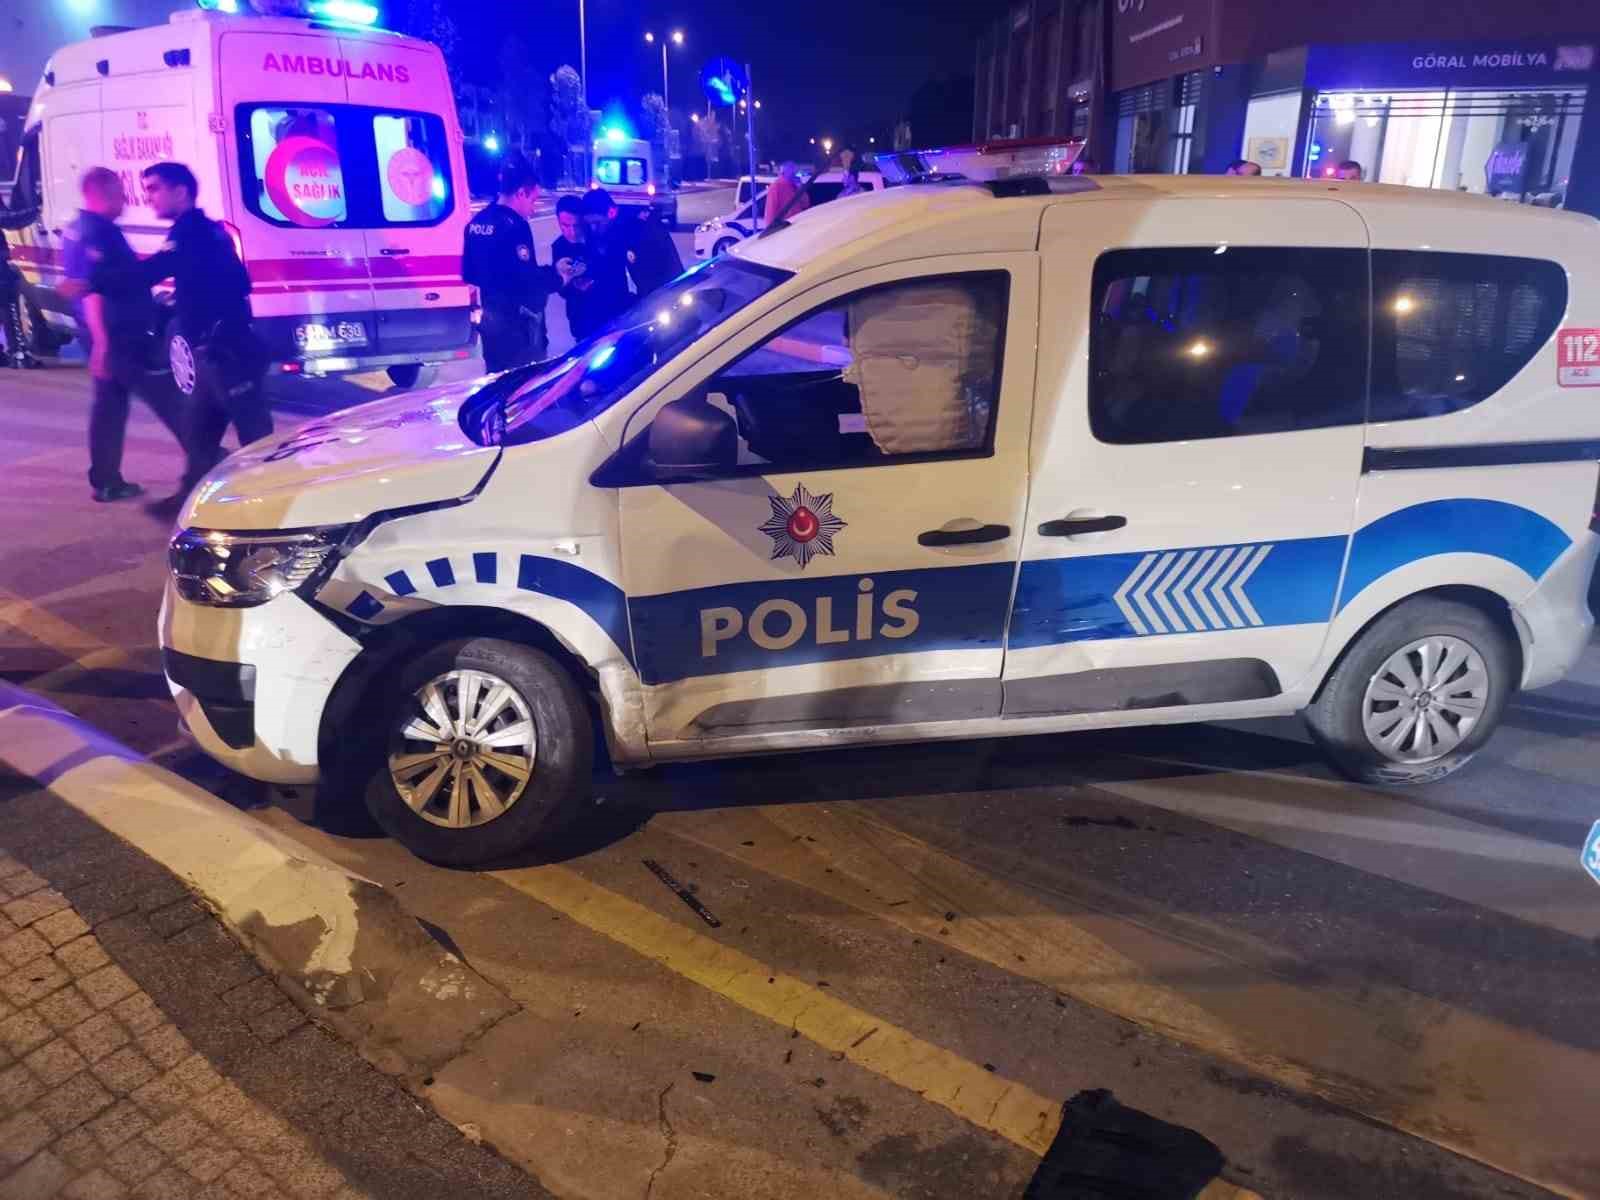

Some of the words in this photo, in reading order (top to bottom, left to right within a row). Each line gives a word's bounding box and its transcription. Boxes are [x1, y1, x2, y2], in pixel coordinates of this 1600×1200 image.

[263, 52, 410, 83] AMBULANS
[1412, 53, 1467, 69] GÖRAL
[1472, 51, 1547, 68] MOBİLYA
[1564, 335, 1599, 362] 112
[700, 577, 920, 657] POLİS
